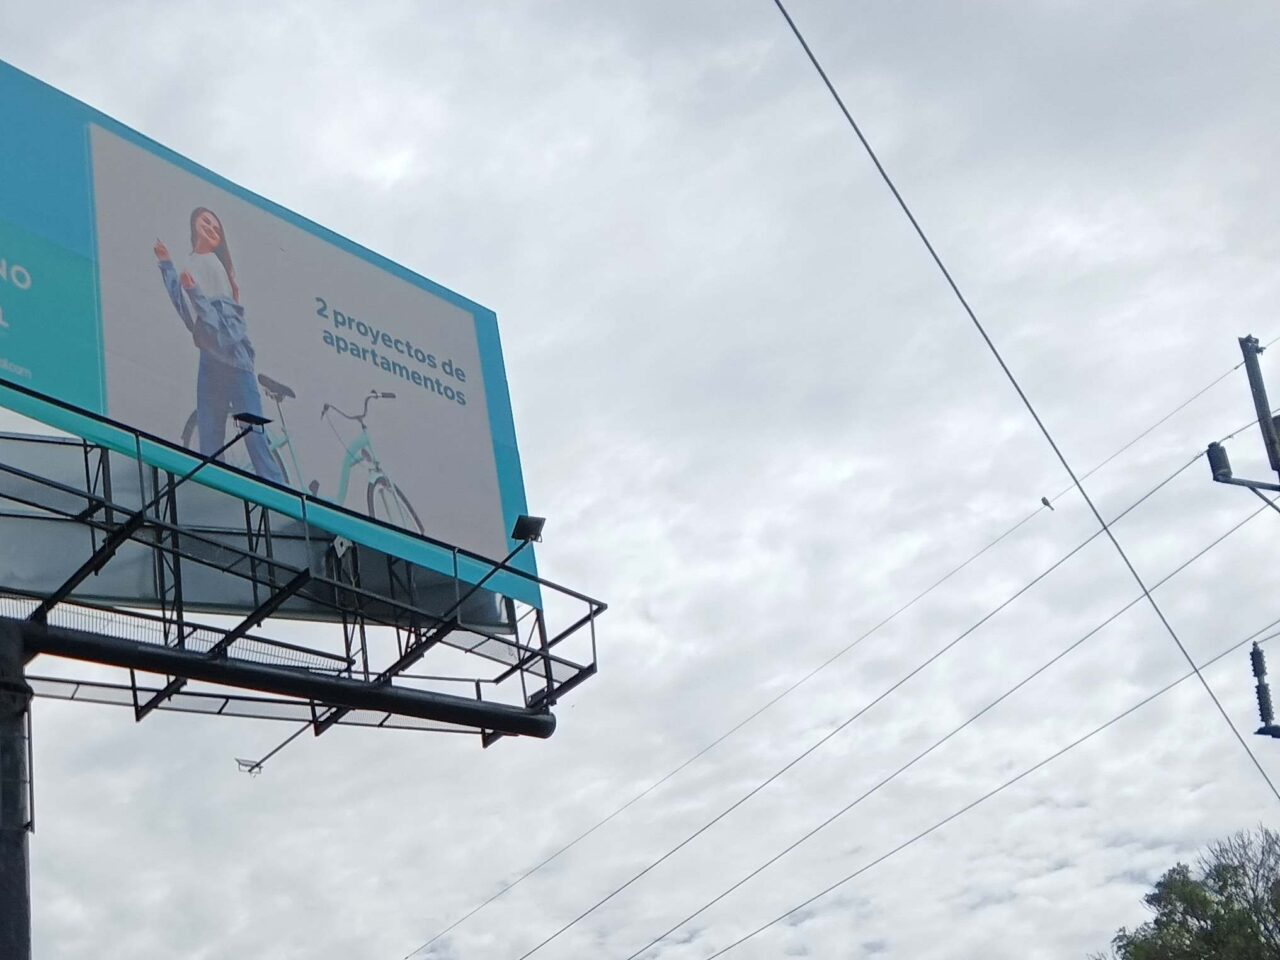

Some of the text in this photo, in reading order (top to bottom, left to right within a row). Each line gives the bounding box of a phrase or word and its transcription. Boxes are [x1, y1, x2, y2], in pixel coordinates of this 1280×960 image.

[315, 296, 467, 383] 2 proyectos de
[322, 329, 467, 407] apartamentos
